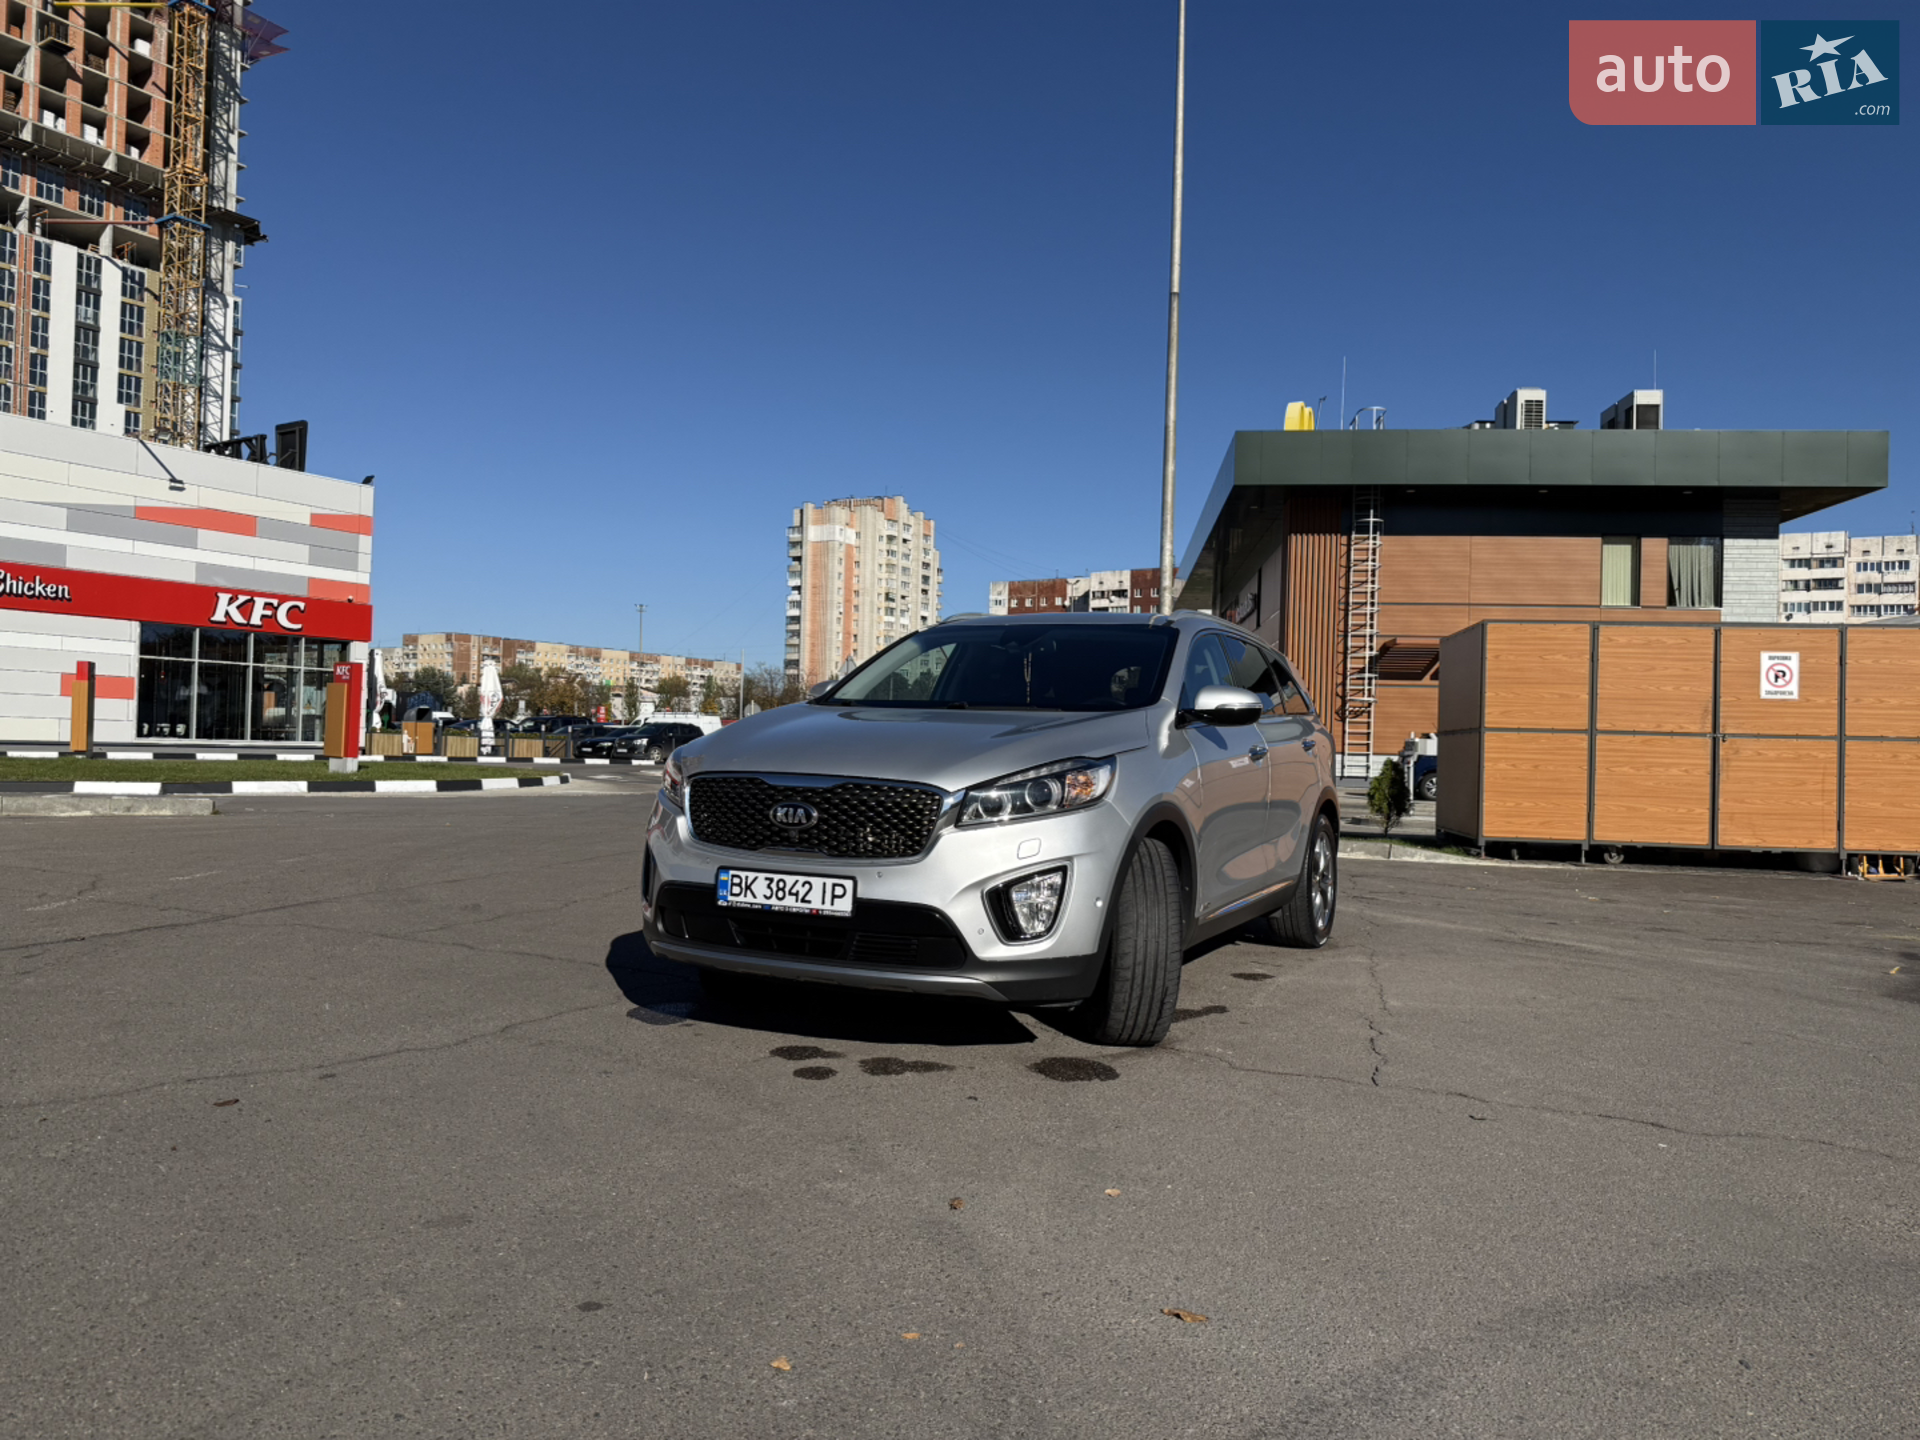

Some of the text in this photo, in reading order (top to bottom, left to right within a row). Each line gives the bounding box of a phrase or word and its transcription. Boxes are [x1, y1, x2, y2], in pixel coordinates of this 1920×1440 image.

[210, 592, 306, 631] KFC
[776, 807, 807, 824] KIA
[730, 874, 848, 907] BK 3842 IP
